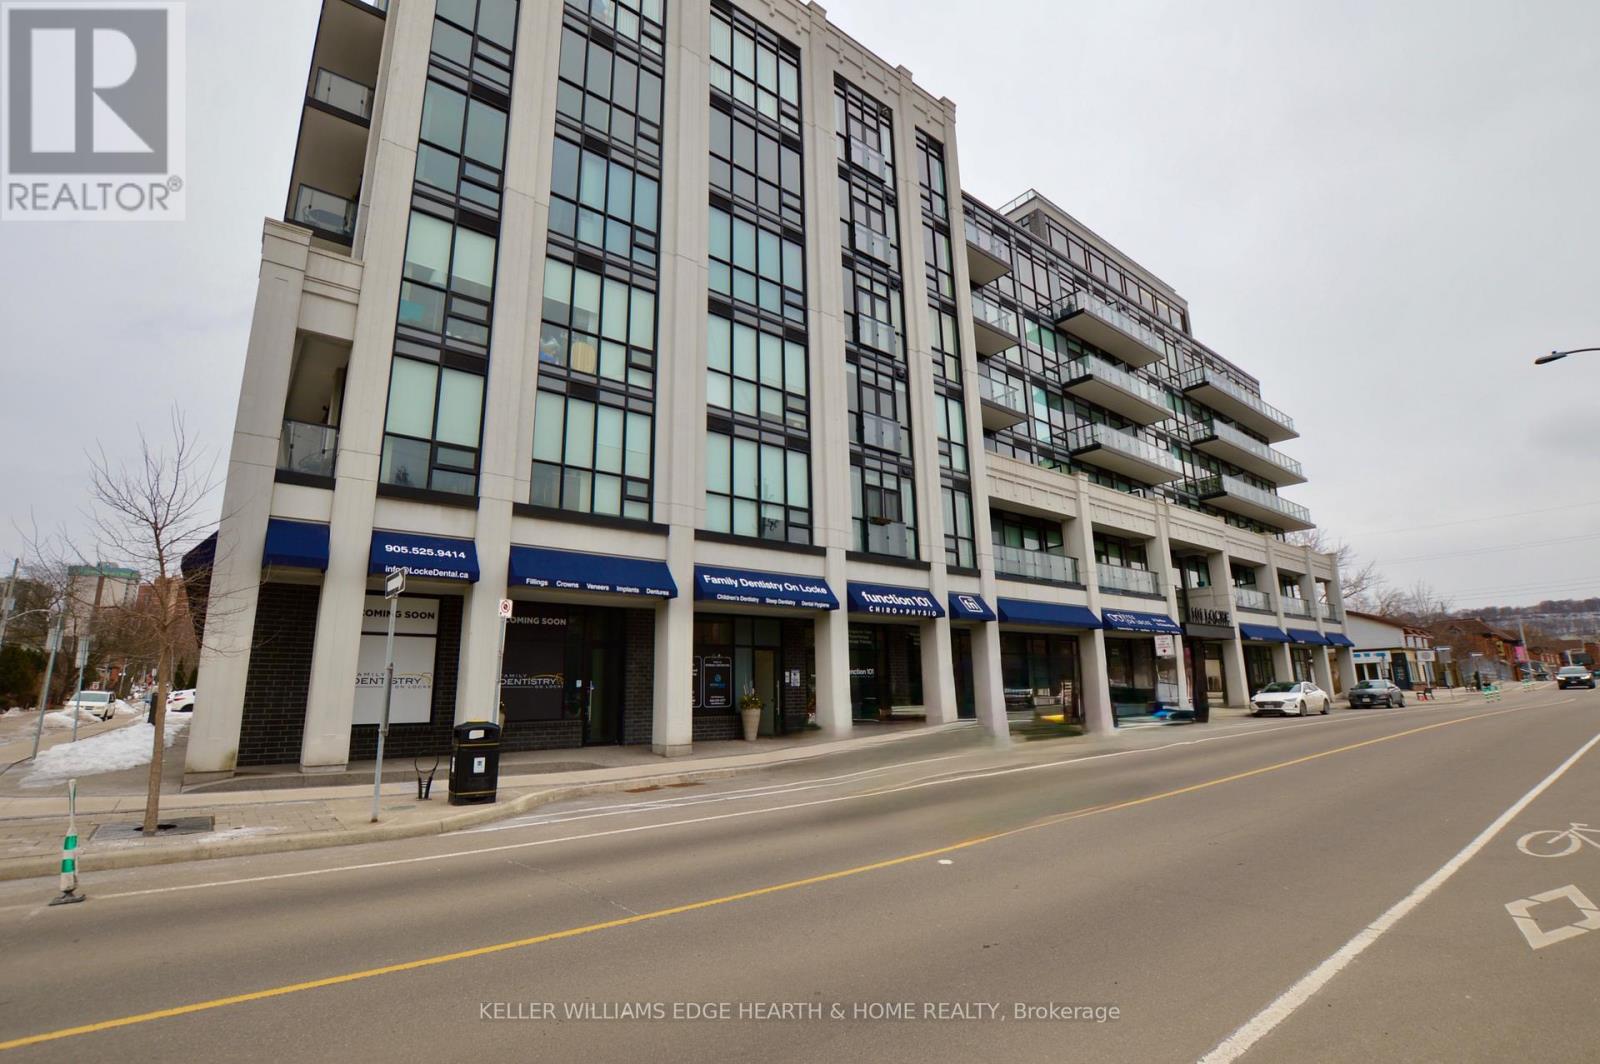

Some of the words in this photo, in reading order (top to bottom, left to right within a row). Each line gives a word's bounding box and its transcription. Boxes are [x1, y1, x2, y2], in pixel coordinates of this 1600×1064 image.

[385, 544, 466, 559] 905.525.9414
[385, 565, 469, 579] info@LockeDental.ca
[526, 577, 548, 587] Fillings
[556, 580, 579, 588] Crowns
[586, 582, 609, 591] Veneers
[703, 575, 738, 587] Family
[740, 578, 783, 592] Dentistry
[784, 583, 799, 591] On
[800, 585, 828, 594] Locke
[616, 585, 639, 594] Implants
[646, 588, 669, 596] Dentures
[717, 593, 739, 601] Children's
[740, 595, 759, 604] Dentistry
[778, 599, 796, 607] Dentistry
[861, 591, 915, 606] function
[912, 597, 933, 608] 101
[363, 609, 402, 618] OMING
[404, 611, 435, 619] SOON
[869, 605, 897, 614] CHIRO
[906, 608, 937, 617] PHYSIO
[355, 677, 422, 685] DENTSTRY
